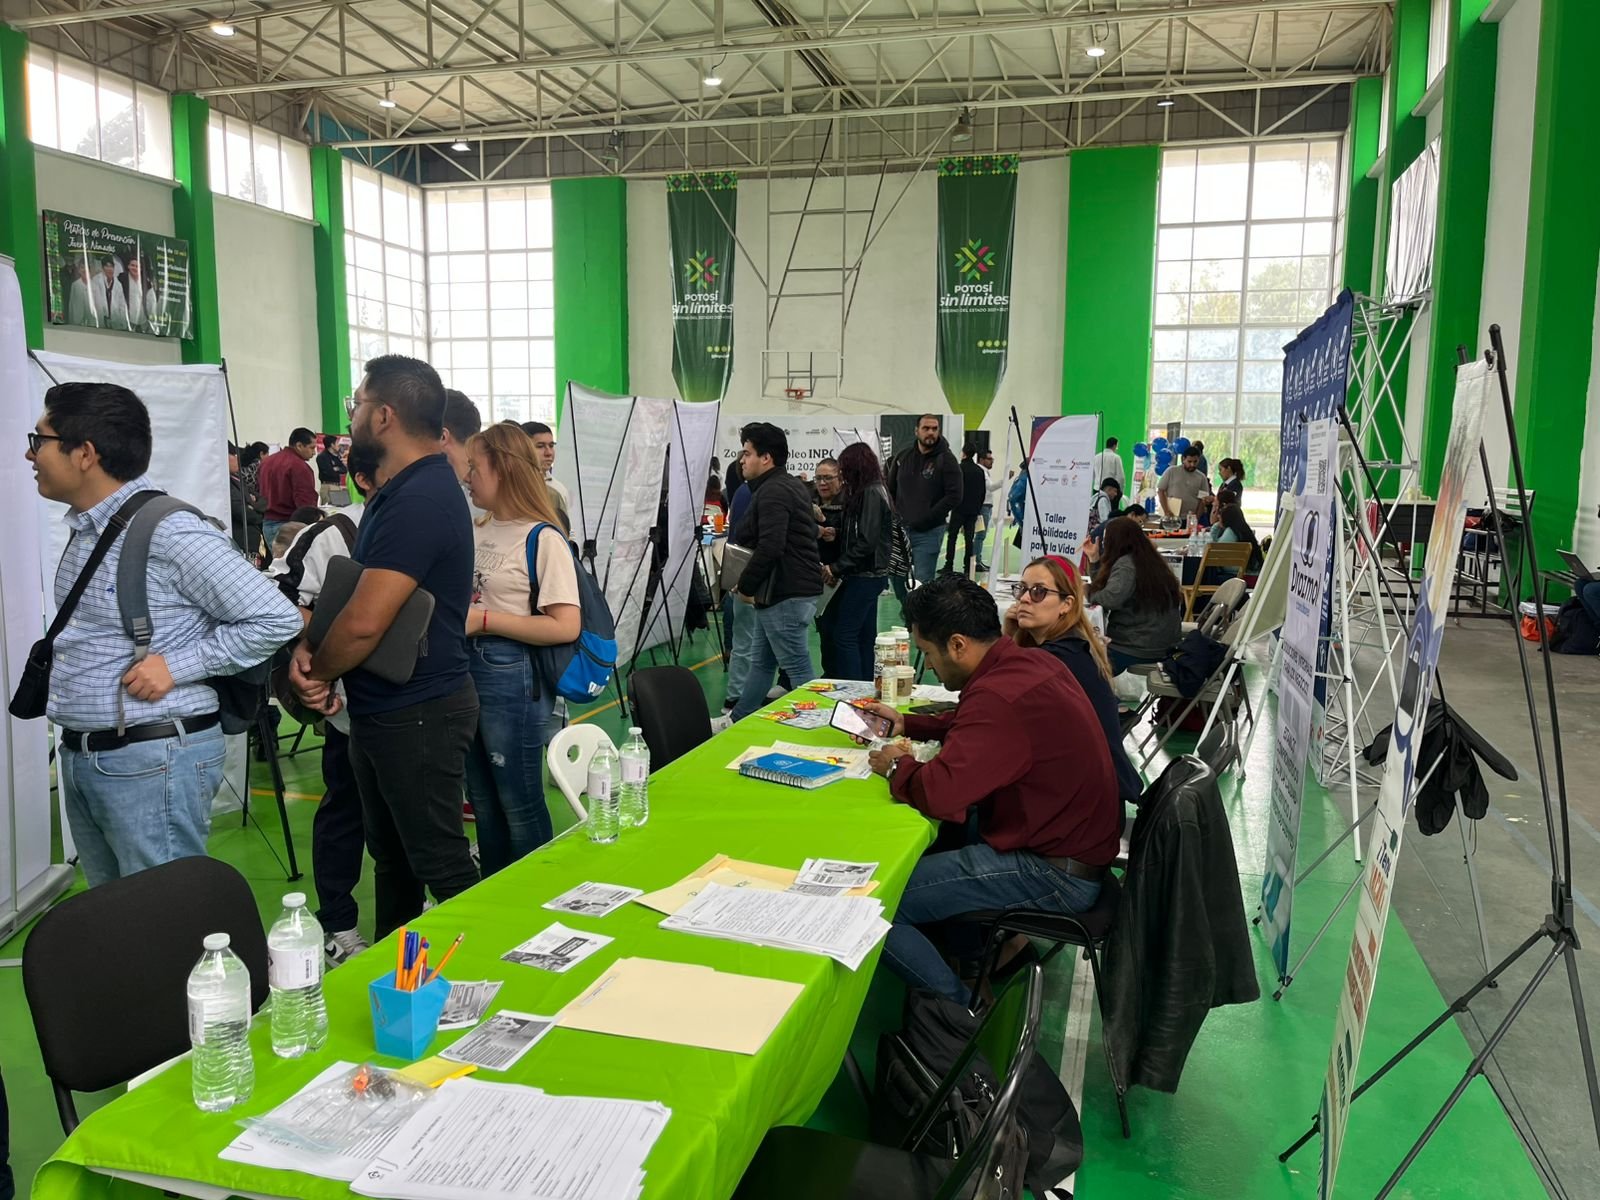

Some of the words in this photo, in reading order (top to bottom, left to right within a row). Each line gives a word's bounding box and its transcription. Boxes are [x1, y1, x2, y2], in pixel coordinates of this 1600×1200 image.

[91, 228, 100, 239] de
[954, 281, 994, 293] POTOSÍ
[684, 290, 719, 301] POTOSÍ
[940, 293, 959, 306] sin
[723, 449, 737, 458] Zo
[797, 462, 818, 471] 202
[1045, 513, 1067, 524] Taller
[1049, 542, 1057, 551] la
[1057, 543, 1076, 555] Vida
